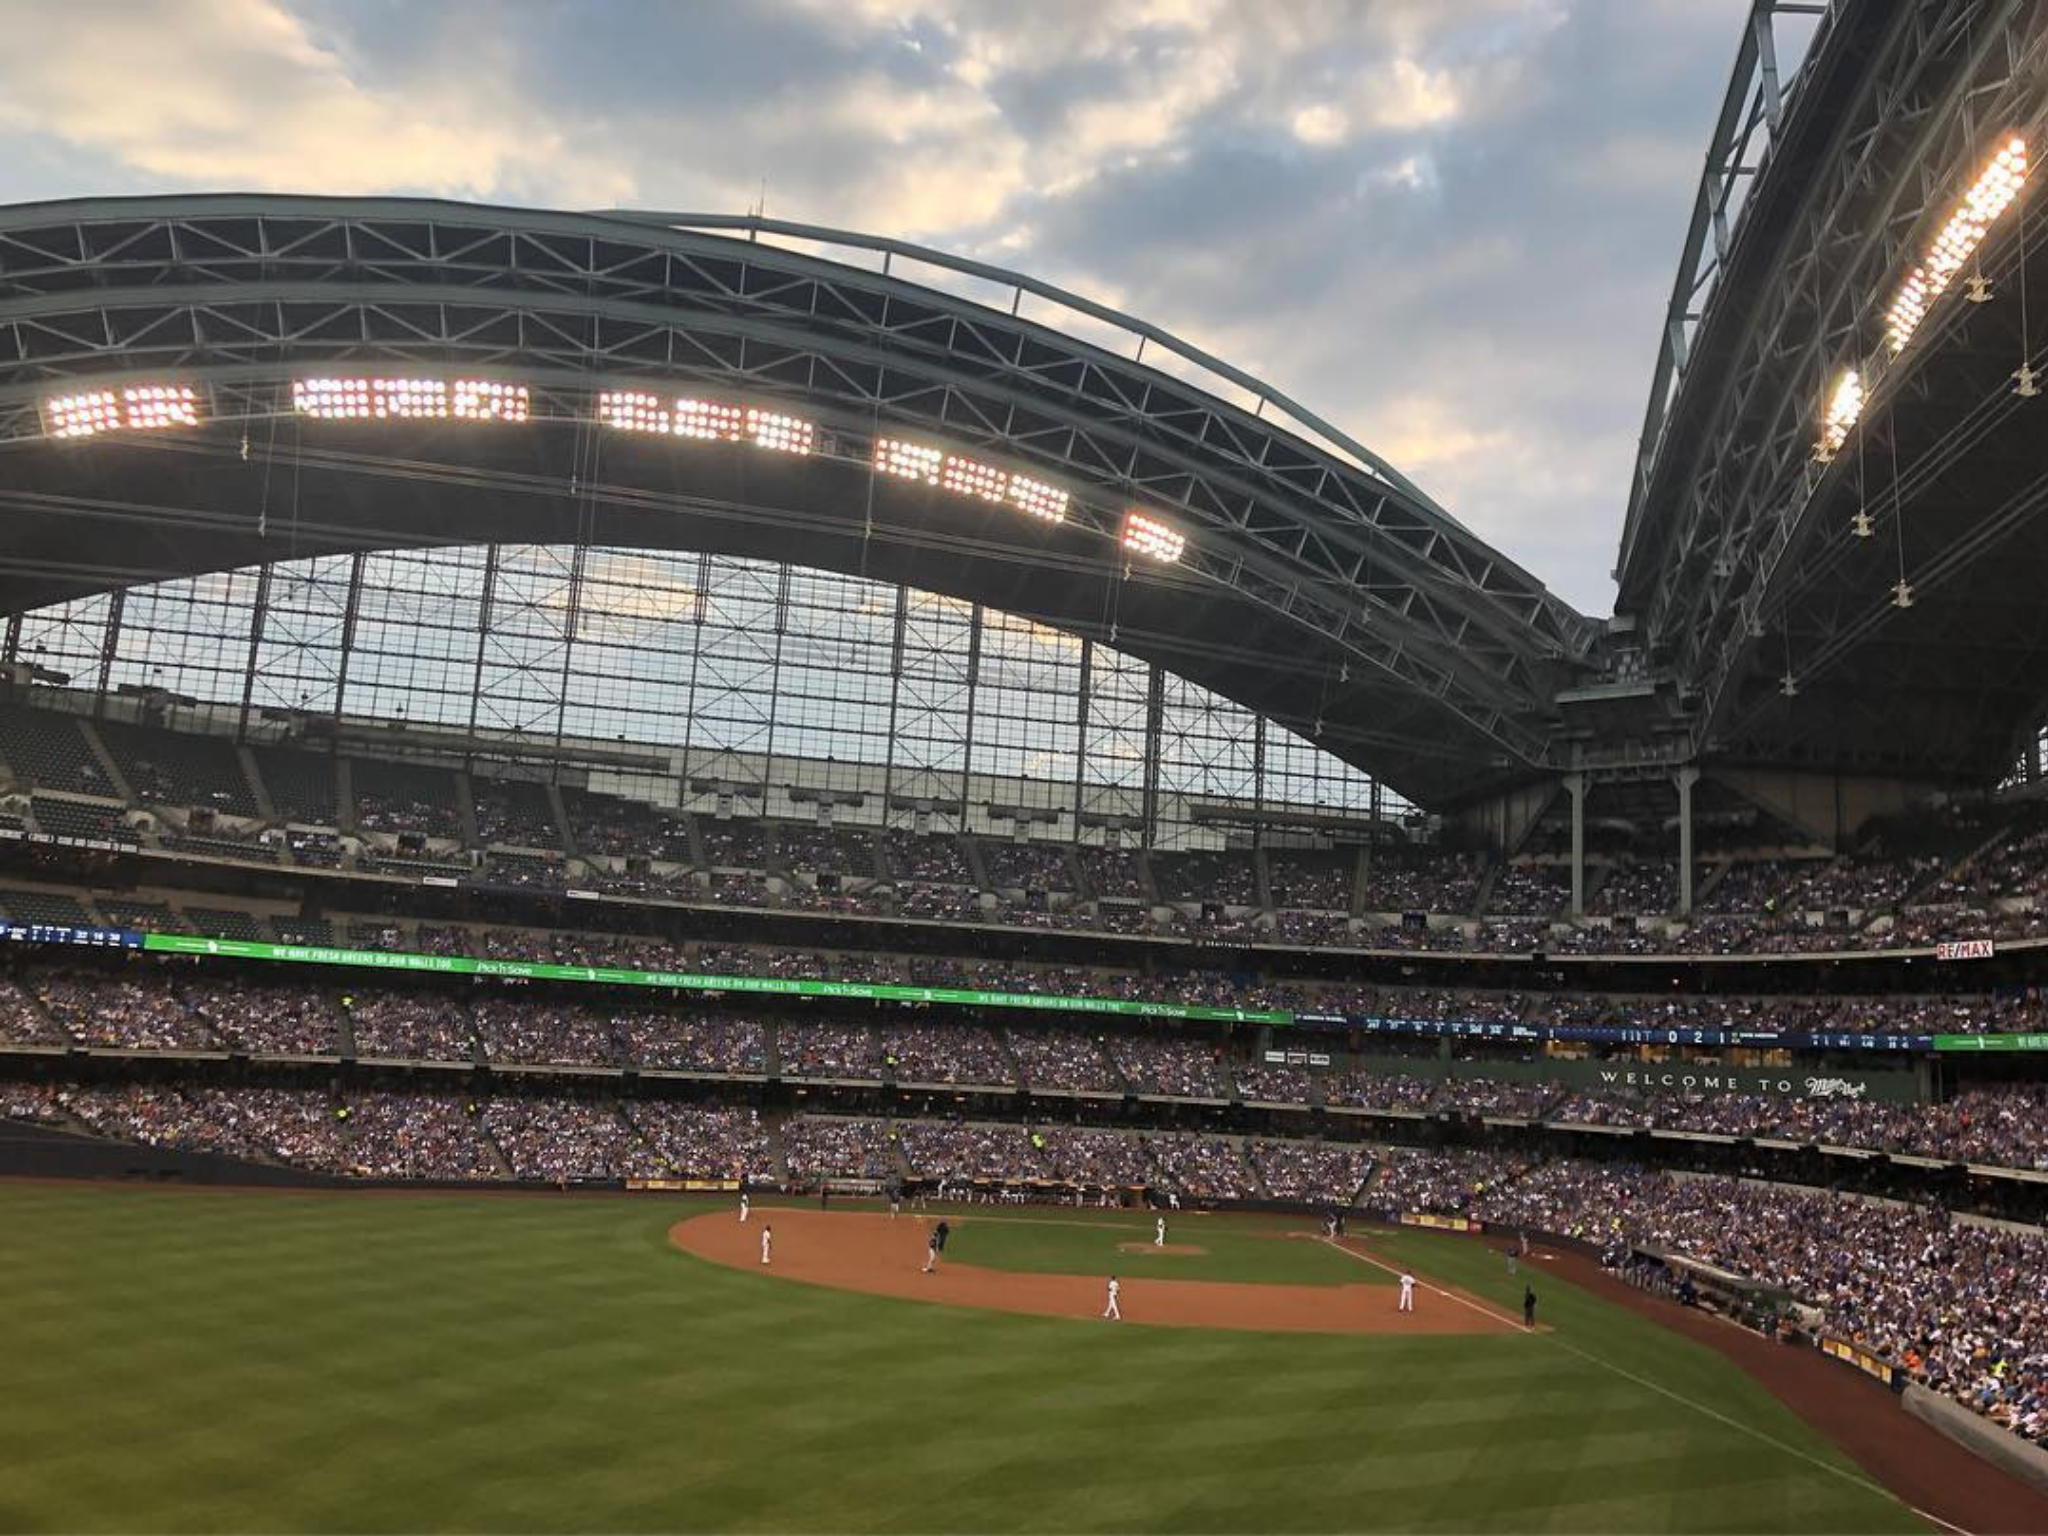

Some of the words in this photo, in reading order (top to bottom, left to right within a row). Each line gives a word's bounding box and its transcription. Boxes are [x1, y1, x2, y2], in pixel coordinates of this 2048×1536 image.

[273, 948, 285, 958] WE
[289, 948, 308, 960] HAVE
[312, 950, 338, 962] FRESH
[1938, 942, 1990, 958] RE/MAX
[1668, 1030, 1678, 1043] 0
[1694, 1030, 1703, 1044] 2
[1600, 1072, 1737, 1090] WELCOME
[1758, 1079, 1792, 1092] TO
